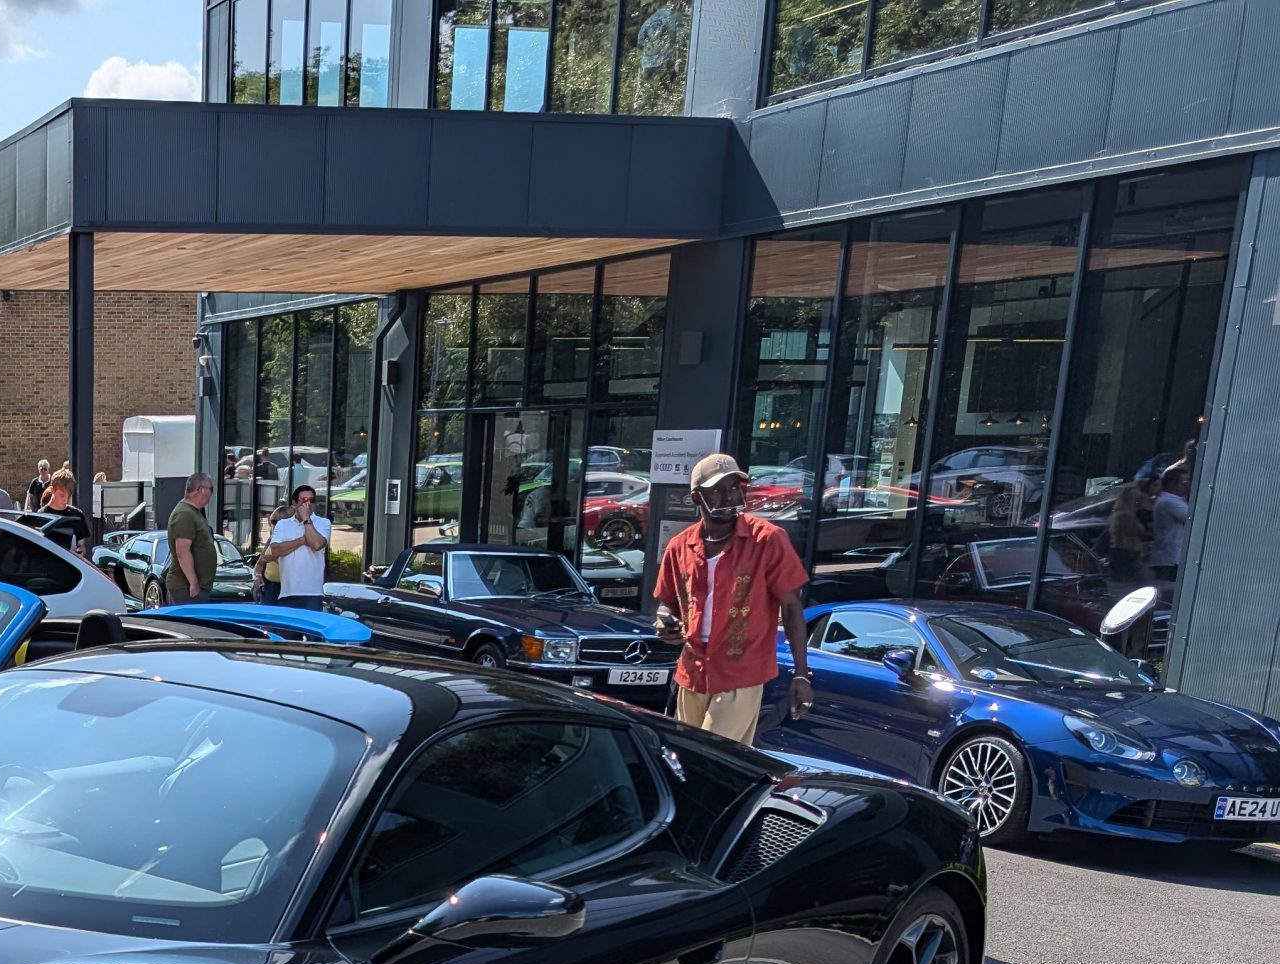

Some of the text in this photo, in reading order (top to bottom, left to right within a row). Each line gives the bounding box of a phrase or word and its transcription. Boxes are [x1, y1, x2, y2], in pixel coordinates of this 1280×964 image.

[620, 671, 660, 682] 1234 SG
[1226, 800, 1268, 817] AE24
